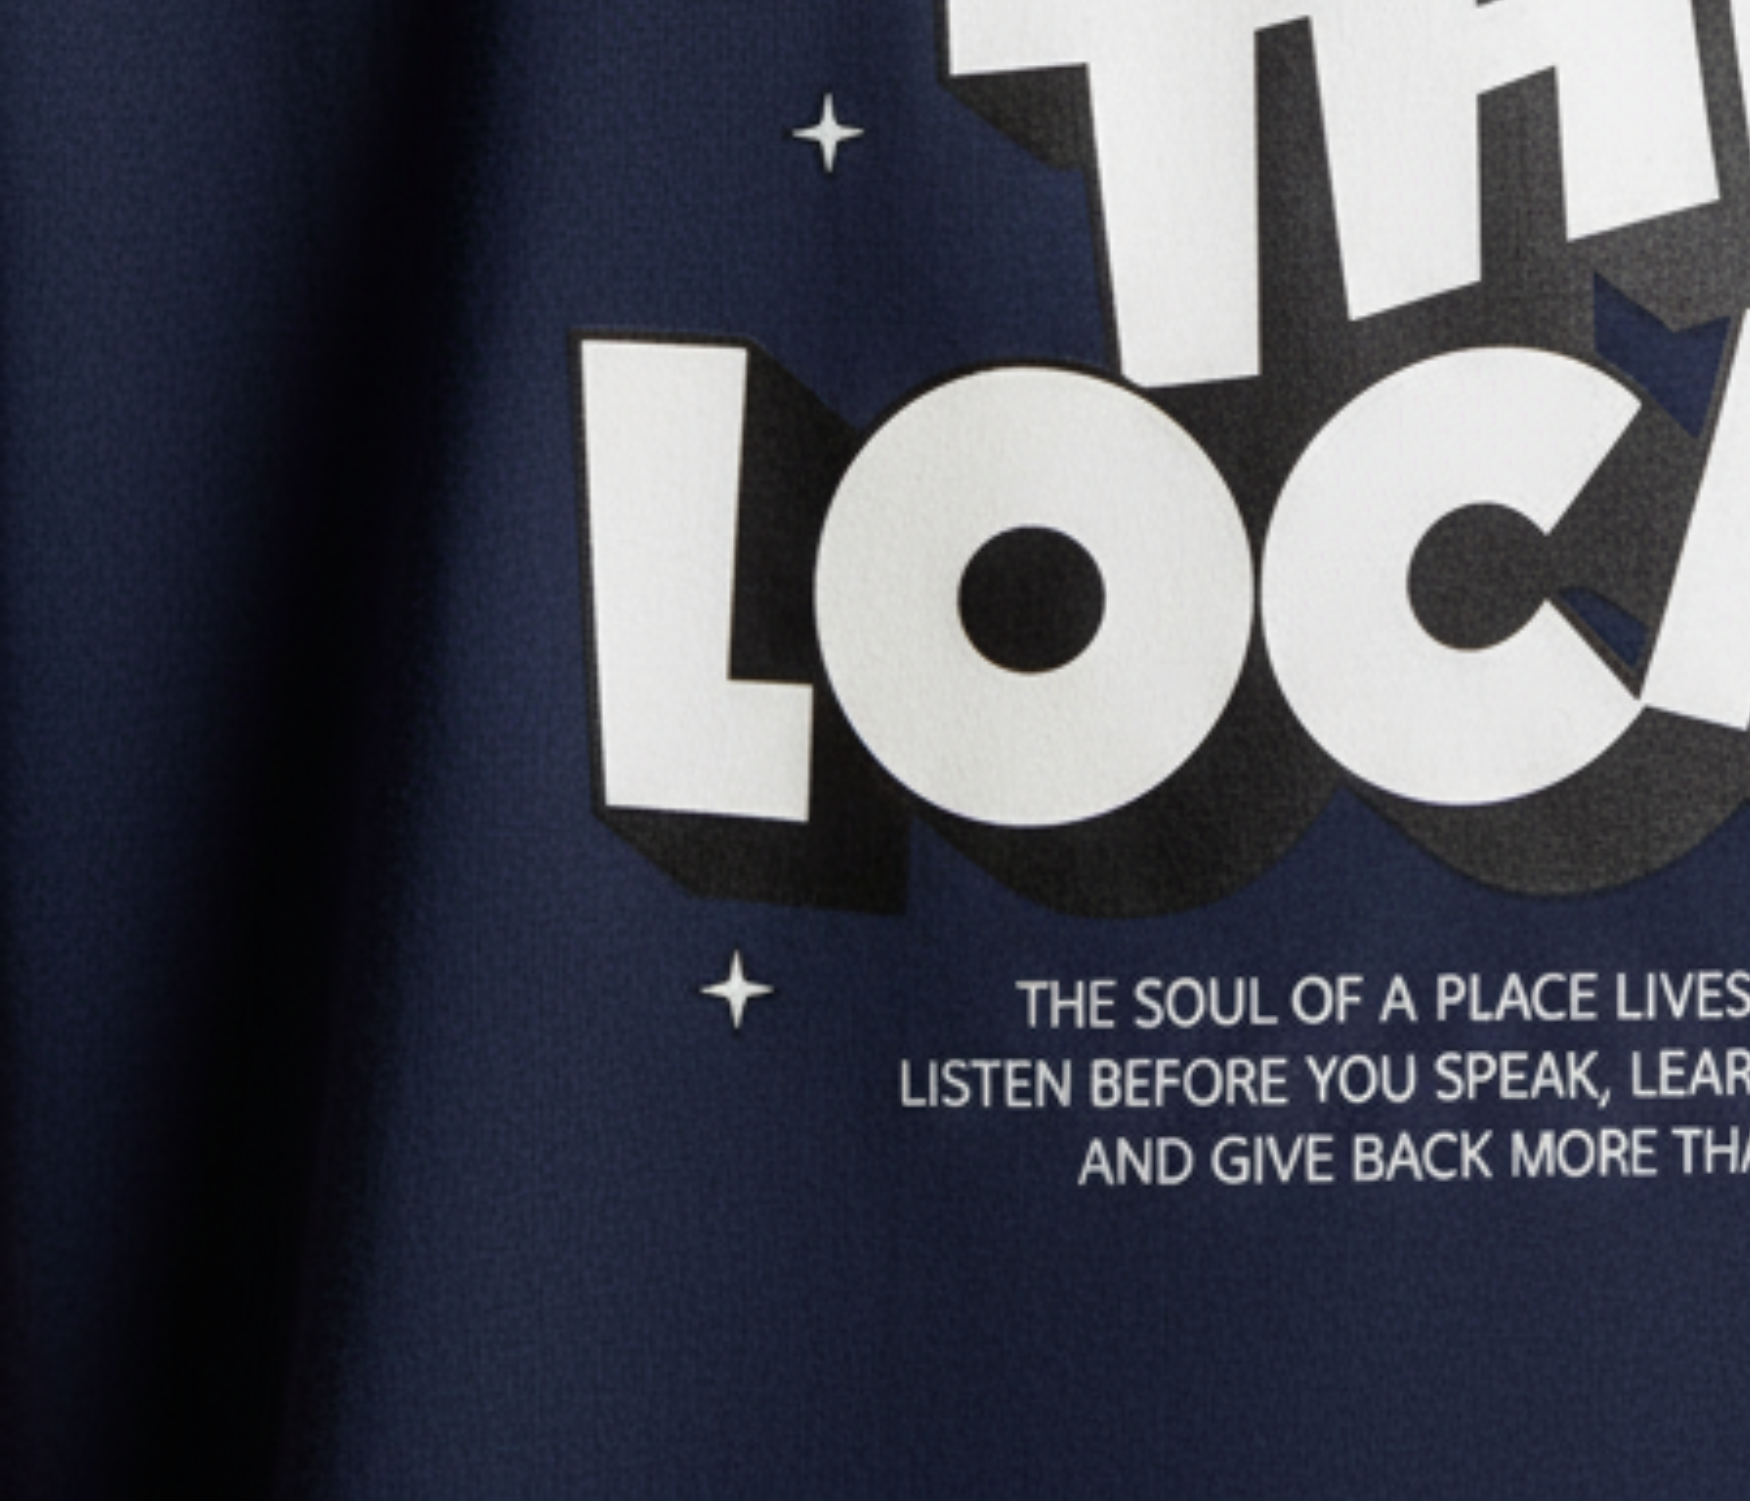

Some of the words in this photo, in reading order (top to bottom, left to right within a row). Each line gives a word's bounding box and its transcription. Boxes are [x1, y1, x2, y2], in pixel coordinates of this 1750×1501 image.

[1016, 979, 1116, 1028] THE
[1135, 976, 1278, 1029] SOUL
[1291, 974, 1364, 1025] OF
[1379, 974, 1418, 1022] A
[1437, 972, 1598, 1022] PLACE
[901, 1059, 1071, 1108] LISTEN
[1091, 1057, 1288, 1108] BEFORE
[1306, 1054, 1416, 1104] YOU
[1434, 1051, 1611, 1108] SPEAK,
[1078, 1137, 1193, 1185] AND
[1211, 1134, 1334, 1185] GIVE
[1353, 1130, 1493, 1182] BACK
[1511, 1127, 1658, 1178] MORE
